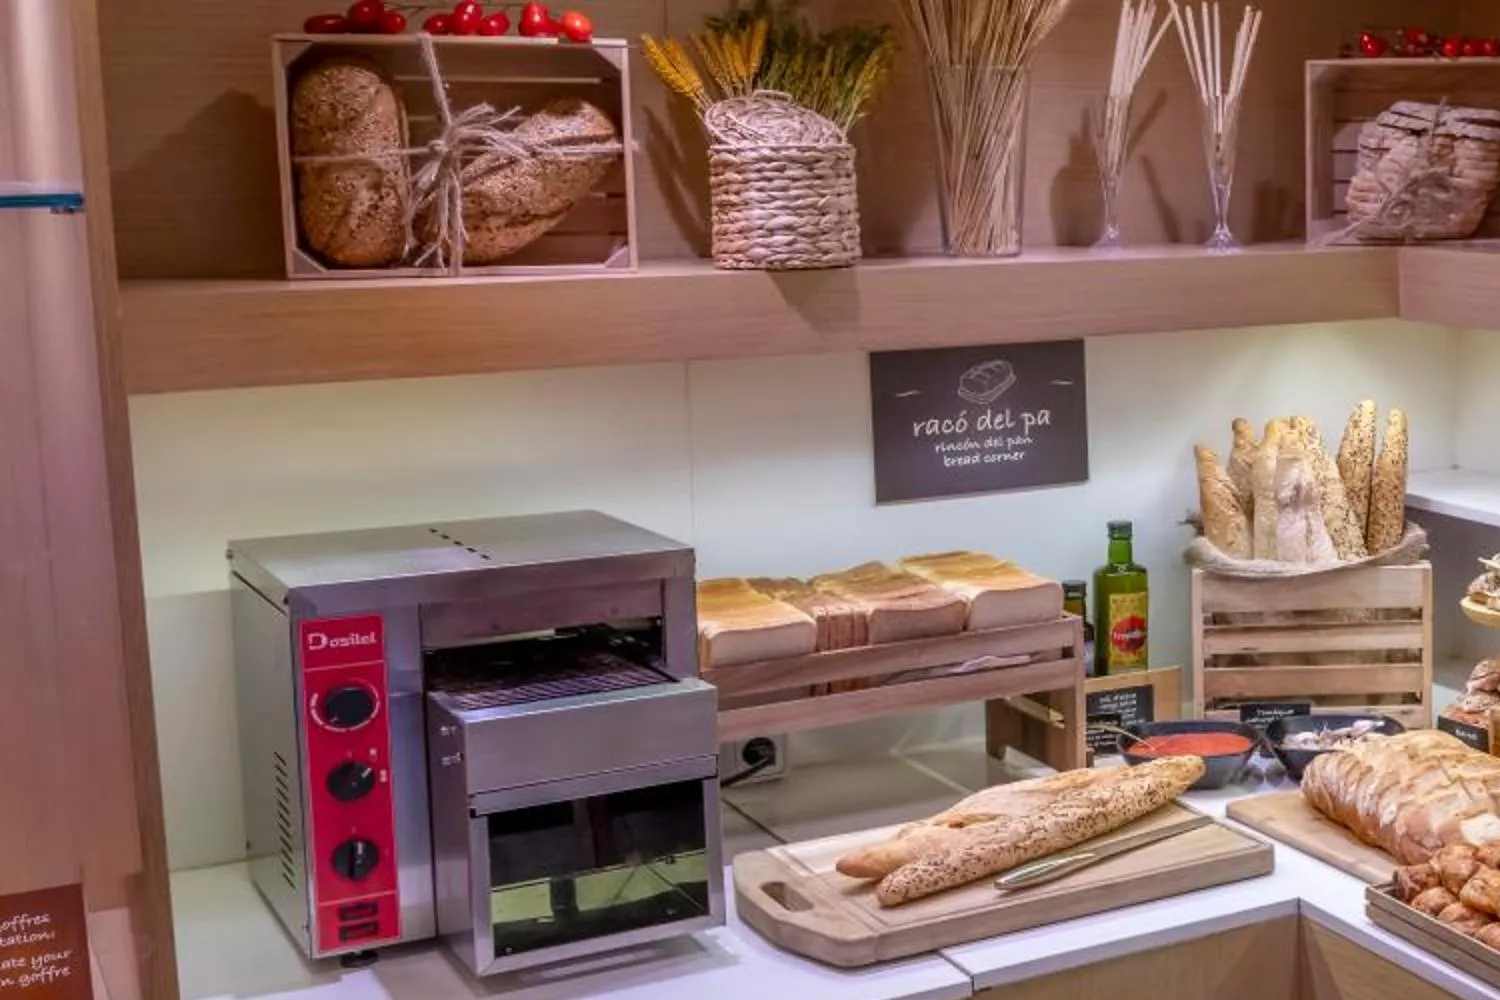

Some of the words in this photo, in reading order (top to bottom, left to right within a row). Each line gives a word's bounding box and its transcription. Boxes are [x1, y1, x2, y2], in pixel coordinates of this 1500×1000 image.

[913, 409, 968, 437] racó
[977, 408, 1015, 431] del
[1021, 409, 1051, 434] pa
[984, 434, 1004, 448] del
[943, 453, 980, 468] bread
